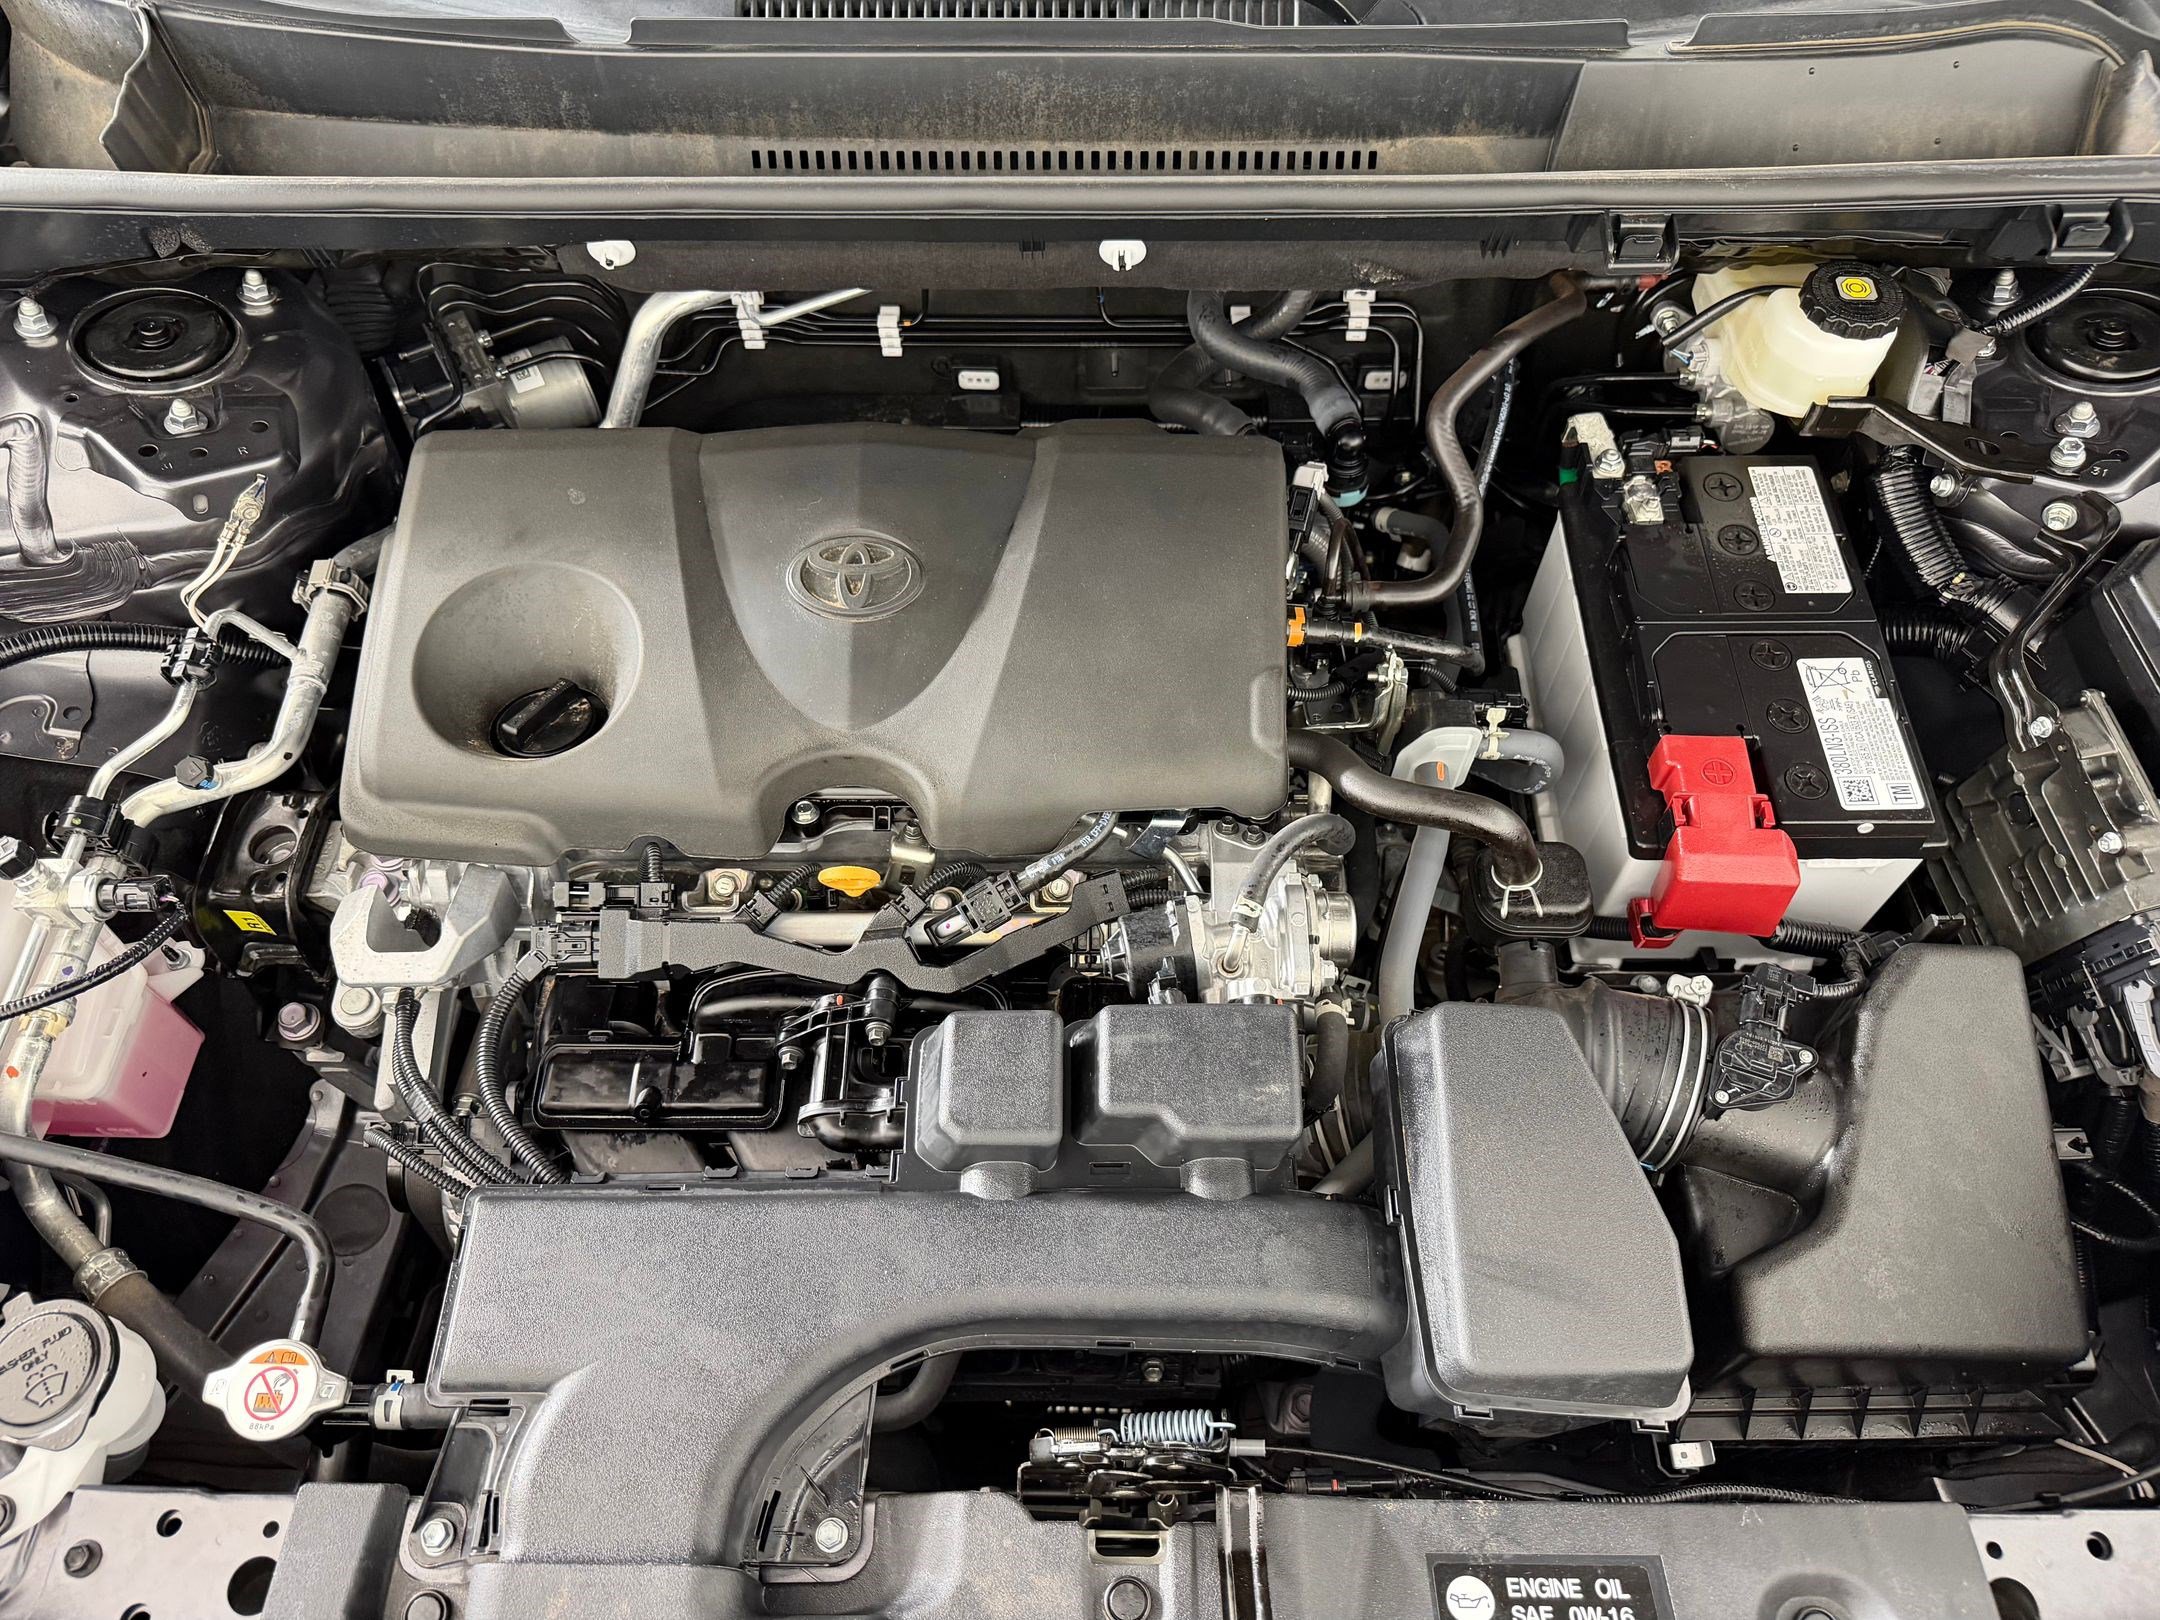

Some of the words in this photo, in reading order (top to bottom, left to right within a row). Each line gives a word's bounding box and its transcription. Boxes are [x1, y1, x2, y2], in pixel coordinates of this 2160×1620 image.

[1851, 669, 1863, 683] Pb
[1864, 659, 1879, 686] CLARIOS
[1817, 717, 1853, 775] 380LN3-ISS
[1890, 785, 1914, 802] TM
[0, 1347, 37, 1375] ASHER
[41, 1326, 72, 1348] FLUID
[22, 1350, 48, 1371] ONLY
[248, 1422, 275, 1432] 88kPa
[1505, 1577, 1584, 1600] ENGINE
[1594, 1578, 1631, 1601] OIL
[1510, 1606, 1554, 1620] SAE
